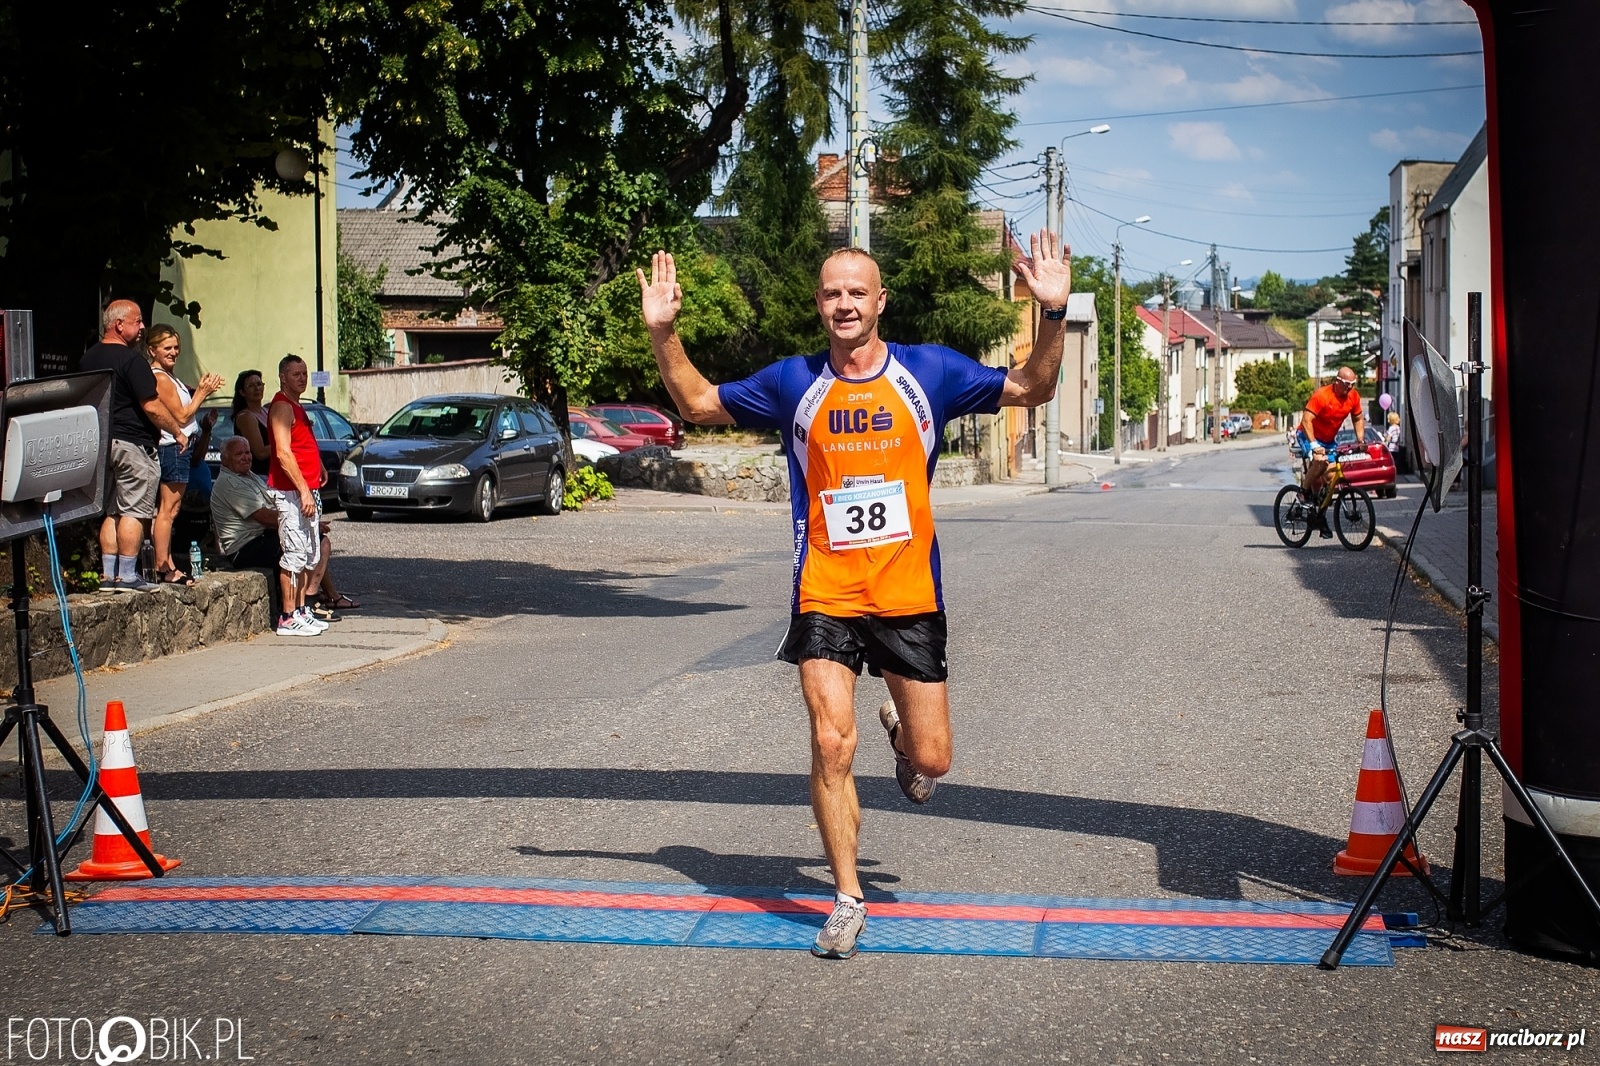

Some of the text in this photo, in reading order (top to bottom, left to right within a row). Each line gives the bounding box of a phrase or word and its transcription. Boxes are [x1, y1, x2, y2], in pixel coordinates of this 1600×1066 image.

[896, 376, 926, 423] SPARKASSE
[829, 409, 868, 434] ULC
[38, 429, 97, 452] CHRONOTRACK
[822, 438, 901, 452] LANGENLOIS
[371, 486, 407, 496] SRC 7J92
[846, 502, 886, 534] 38
